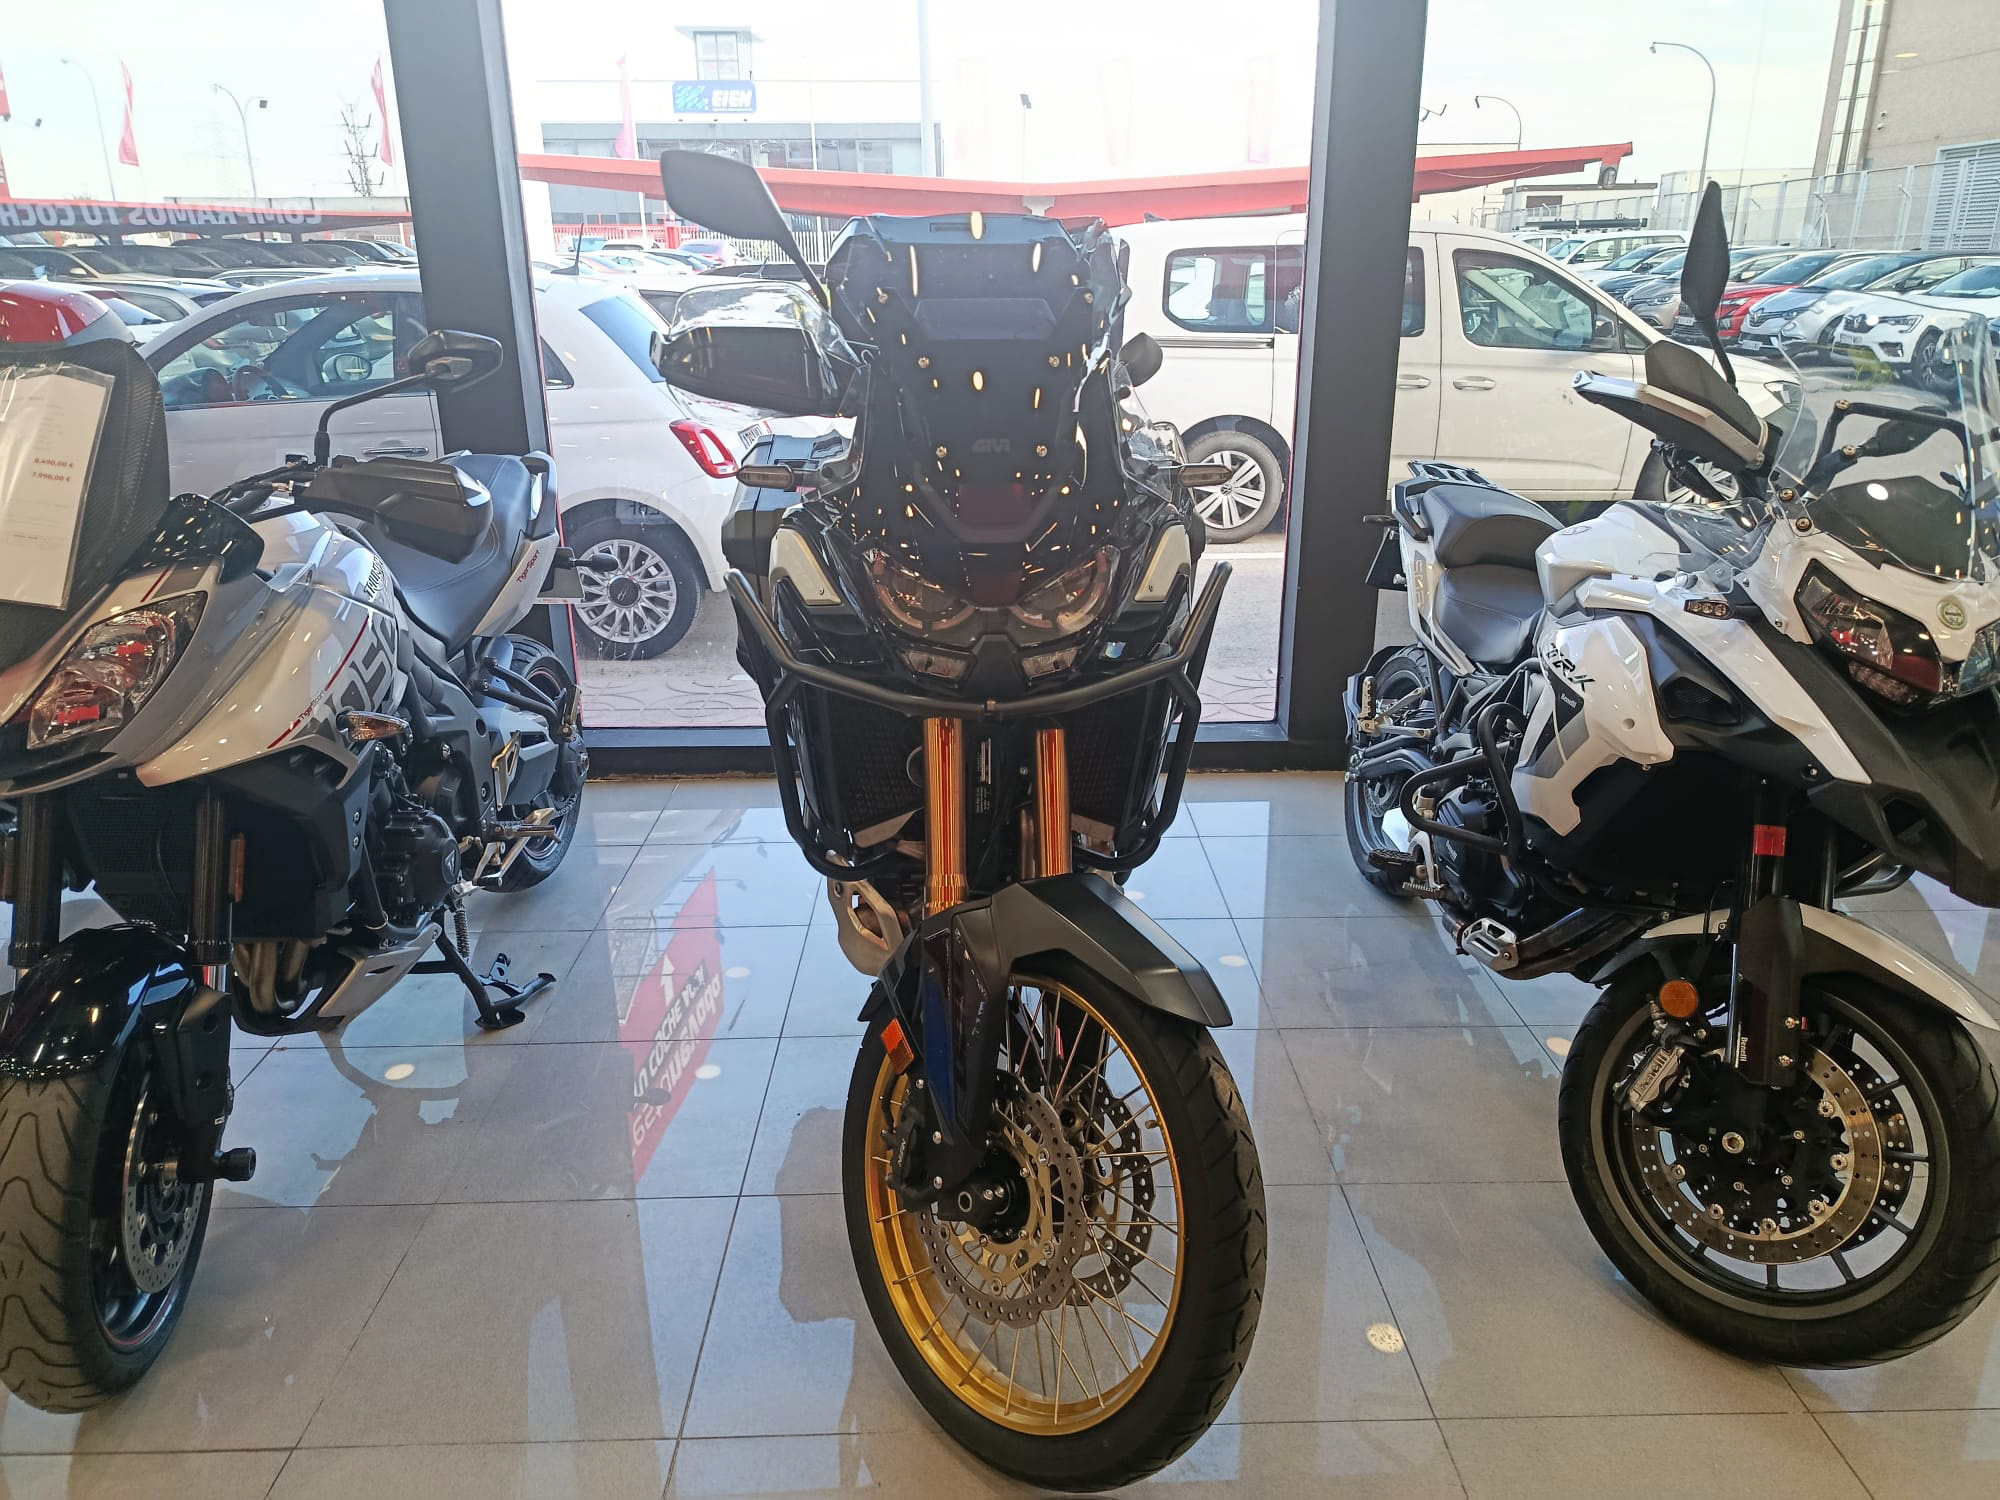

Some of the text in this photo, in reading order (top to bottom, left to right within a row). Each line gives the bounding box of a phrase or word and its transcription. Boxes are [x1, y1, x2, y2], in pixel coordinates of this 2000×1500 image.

[971, 438, 1010, 453] GIVI
[517, 549, 541, 583] TigerSport
[1547, 642, 1596, 693] TRK
[299, 689, 327, 722] TigerSport
[1740, 1037, 1748, 1062] Benelli
